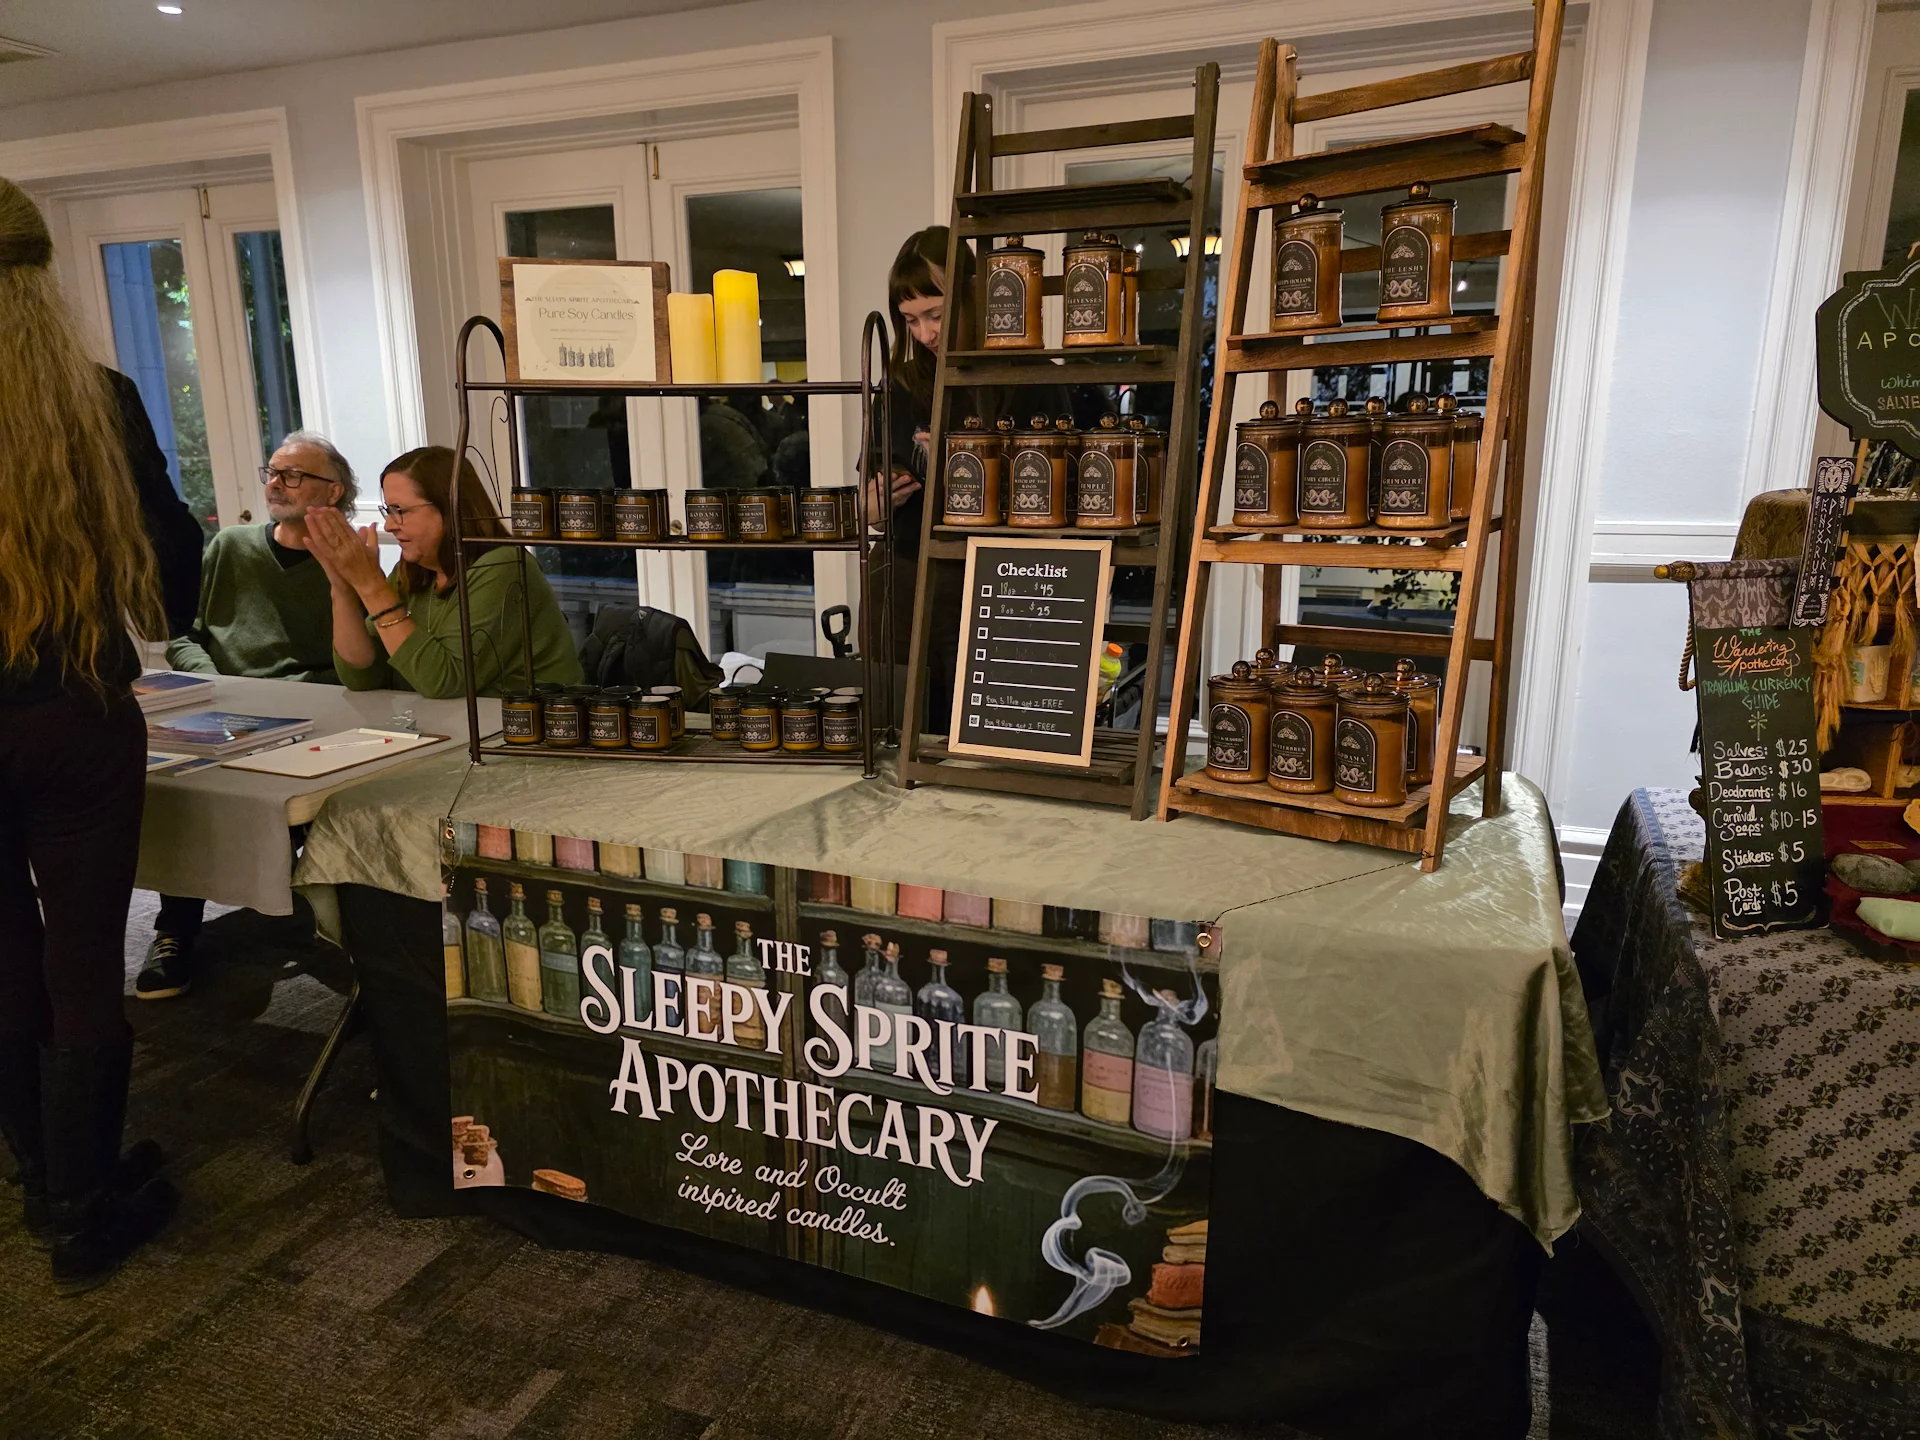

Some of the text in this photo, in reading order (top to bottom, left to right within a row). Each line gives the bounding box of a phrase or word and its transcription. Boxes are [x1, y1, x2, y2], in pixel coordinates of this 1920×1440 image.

[539, 307, 634, 323] Pure Soy Candles
[996, 562, 1068, 578] Checklist
[1740, 628, 1762, 636] THE
[1713, 635, 1796, 660] Wandering
[1717, 653, 1800, 678] Apothecary
[1752, 677, 1811, 693] CURRENCY
[1042, 698, 1065, 709] FREE
[1742, 693, 1781, 710] GUIDE
[1036, 721, 1057, 732] FREE
[1713, 738, 1808, 760] Salves: $25
[1714, 758, 1813, 779] Balms: $30
[1709, 781, 1808, 803] Deodorants: $16
[1722, 840, 1805, 873] Stickers: $5
[1771, 879, 1799, 907] $5
[756, 938, 811, 976] THE
[579, 945, 795, 1055] SLEEPY
[803, 983, 1041, 1105] SPRITE
[609, 1036, 999, 1188] APOTHECARY
[675, 1132, 908, 1212] Lore and Occult
[677, 1175, 897, 1248] inspired candles.
